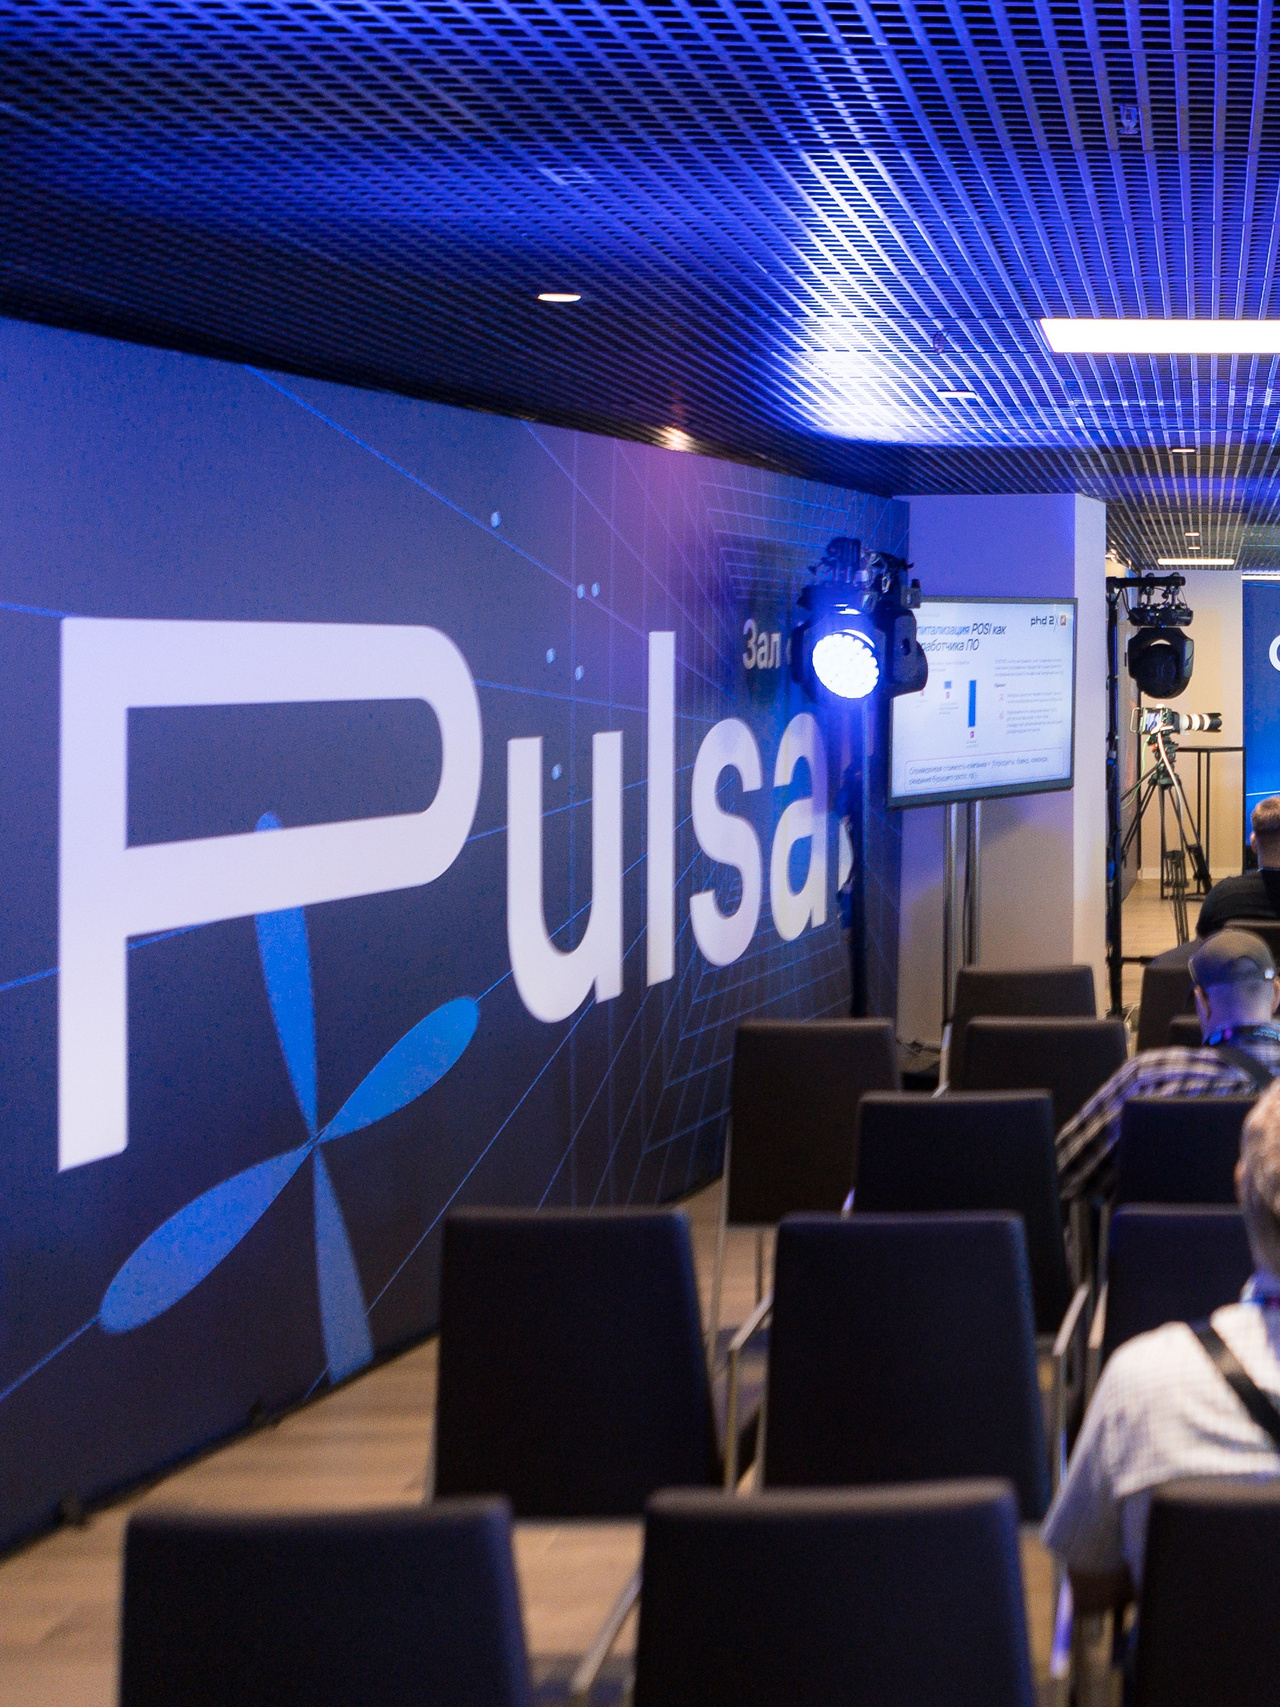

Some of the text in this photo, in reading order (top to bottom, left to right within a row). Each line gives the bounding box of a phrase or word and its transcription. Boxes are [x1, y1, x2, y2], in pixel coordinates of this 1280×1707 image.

[742, 617, 782, 670] Зал
[971, 622, 993, 636] POSI
[992, 625, 1007, 635] как
[58, 616, 854, 1173] Pulsa
